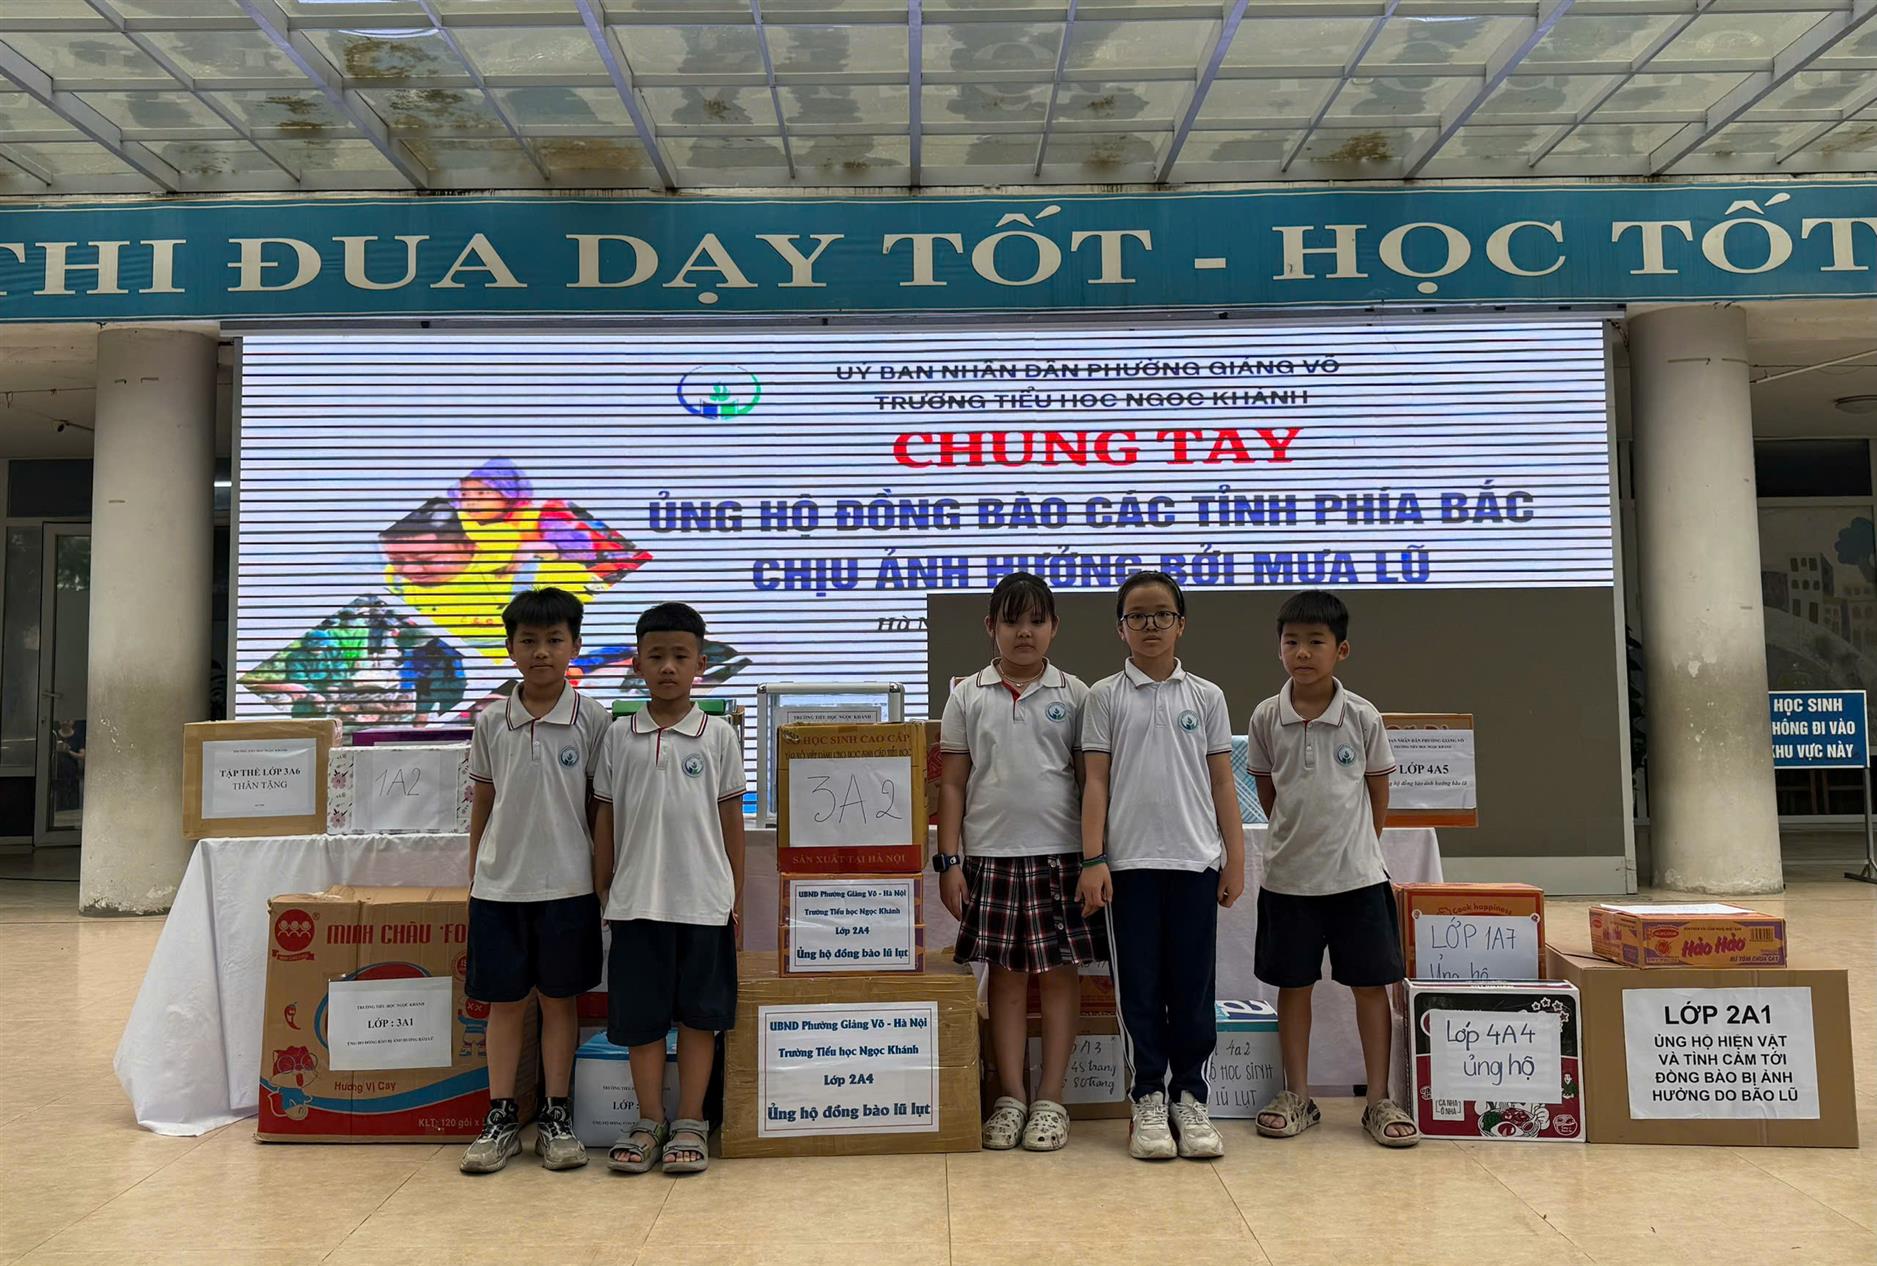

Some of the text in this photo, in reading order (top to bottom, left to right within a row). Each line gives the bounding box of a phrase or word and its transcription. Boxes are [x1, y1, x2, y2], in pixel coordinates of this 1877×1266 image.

[227, 233, 528, 293] ĐUA
[565, 232, 845, 304] DẠY
[882, 204, 1152, 286] TỐT
[1193, 257, 1226, 269] -
[1271, 220, 1566, 294] HỌC
[1611, 192, 1877, 274] TỐT
[880, 366, 934, 380] BAN
[942, 359, 1017, 379] NHÂN
[994, 386, 1051, 408] TIỂU
[893, 427, 1305, 469] CHUNG TAY
[650, 490, 742, 533] ỦNG
[760, 493, 819, 538] HỘ
[835, 488, 960, 532] ĐỒNG
[978, 490, 1068, 530] BÀO
[1086, 489, 1175, 529] CÁC
[1191, 484, 1297, 527] TỈNH
[1314, 486, 1424, 526] PHÍA
[752, 557, 858, 597] CHỊU
[875, 546, 969, 591] ẢNH
[1253, 548, 1359, 585] MƯA
[1375, 544, 1430, 584] LŨ
[1773, 698, 1843, 716] HỌC SINH
[1772, 718, 1856, 735] HÔNG ĐI VÀO
[830, 735, 857, 745] SINH
[860, 734, 885, 744] CAO
[1797, 743, 1823, 761] VỰC
[1826, 740, 1854, 759] NÀY
[283, 767, 301, 776] 3A6
[1400, 762, 1449, 775] LỚP 4A5
[375, 767, 422, 797] 1A2
[798, 890, 819, 898] UBND
[883, 889, 893, 897] Hà
[894, 889, 907, 897] Nội
[846, 908, 858, 916] học
[859, 908, 876, 916] Ngọc
[878, 907, 901, 915] Khánh
[1452, 904, 1472, 915] Cook
[835, 926, 870, 936] Lớp 2A4
[1431, 916, 1518, 950] LỚP 1A7
[796, 946, 817, 960] Ủng
[819, 949, 832, 960] hộ
[862, 948, 880, 958] bào
[895, 948, 909, 959] lụt
[1681, 932, 1746, 958] Hảo Hảo
[1664, 1001, 1771, 1025] LỚP 2A1
[368, 1016, 414, 1029] LỚP 3A1
[769, 1021, 799, 1031] UBND
[801, 1020, 838, 1031] Phường
[871, 1019, 885, 1029] Võ
[893, 1018, 907, 1028] Hà
[909, 1017, 928, 1029] Nội
[1447, 1019, 1536, 1051] Lớp 4A4
[1654, 1033, 1787, 1050] ỦNG HỘ HIỆN VẬT
[779, 1047, 813, 1059] Trường
[839, 1046, 857, 1058] học
[859, 1046, 885, 1057] Ngọc
[887, 1045, 919, 1054] Khánh
[1658, 1050, 1787, 1065] VÀ TÌNH CẢM TỚI
[1463, 1053, 1535, 1086] ủng hộ
[1655, 1069, 1793, 1086] ĐỒNG BÀO BỊ ẢNH
[366, 1082, 375, 1093] Vị
[377, 1081, 397, 1092] Cay
[824, 1073, 874, 1087] Lớp 2A4
[1652, 1087, 1798, 1101] HƯỞNG DO BÃO LŨ
[613, 1099, 635, 1111] LỚP
[768, 1102, 931, 1122] Ủng hộ đồng bào lũ lụt
[441, 1118, 456, 1127] 120
[458, 1117, 472, 1129] gói
